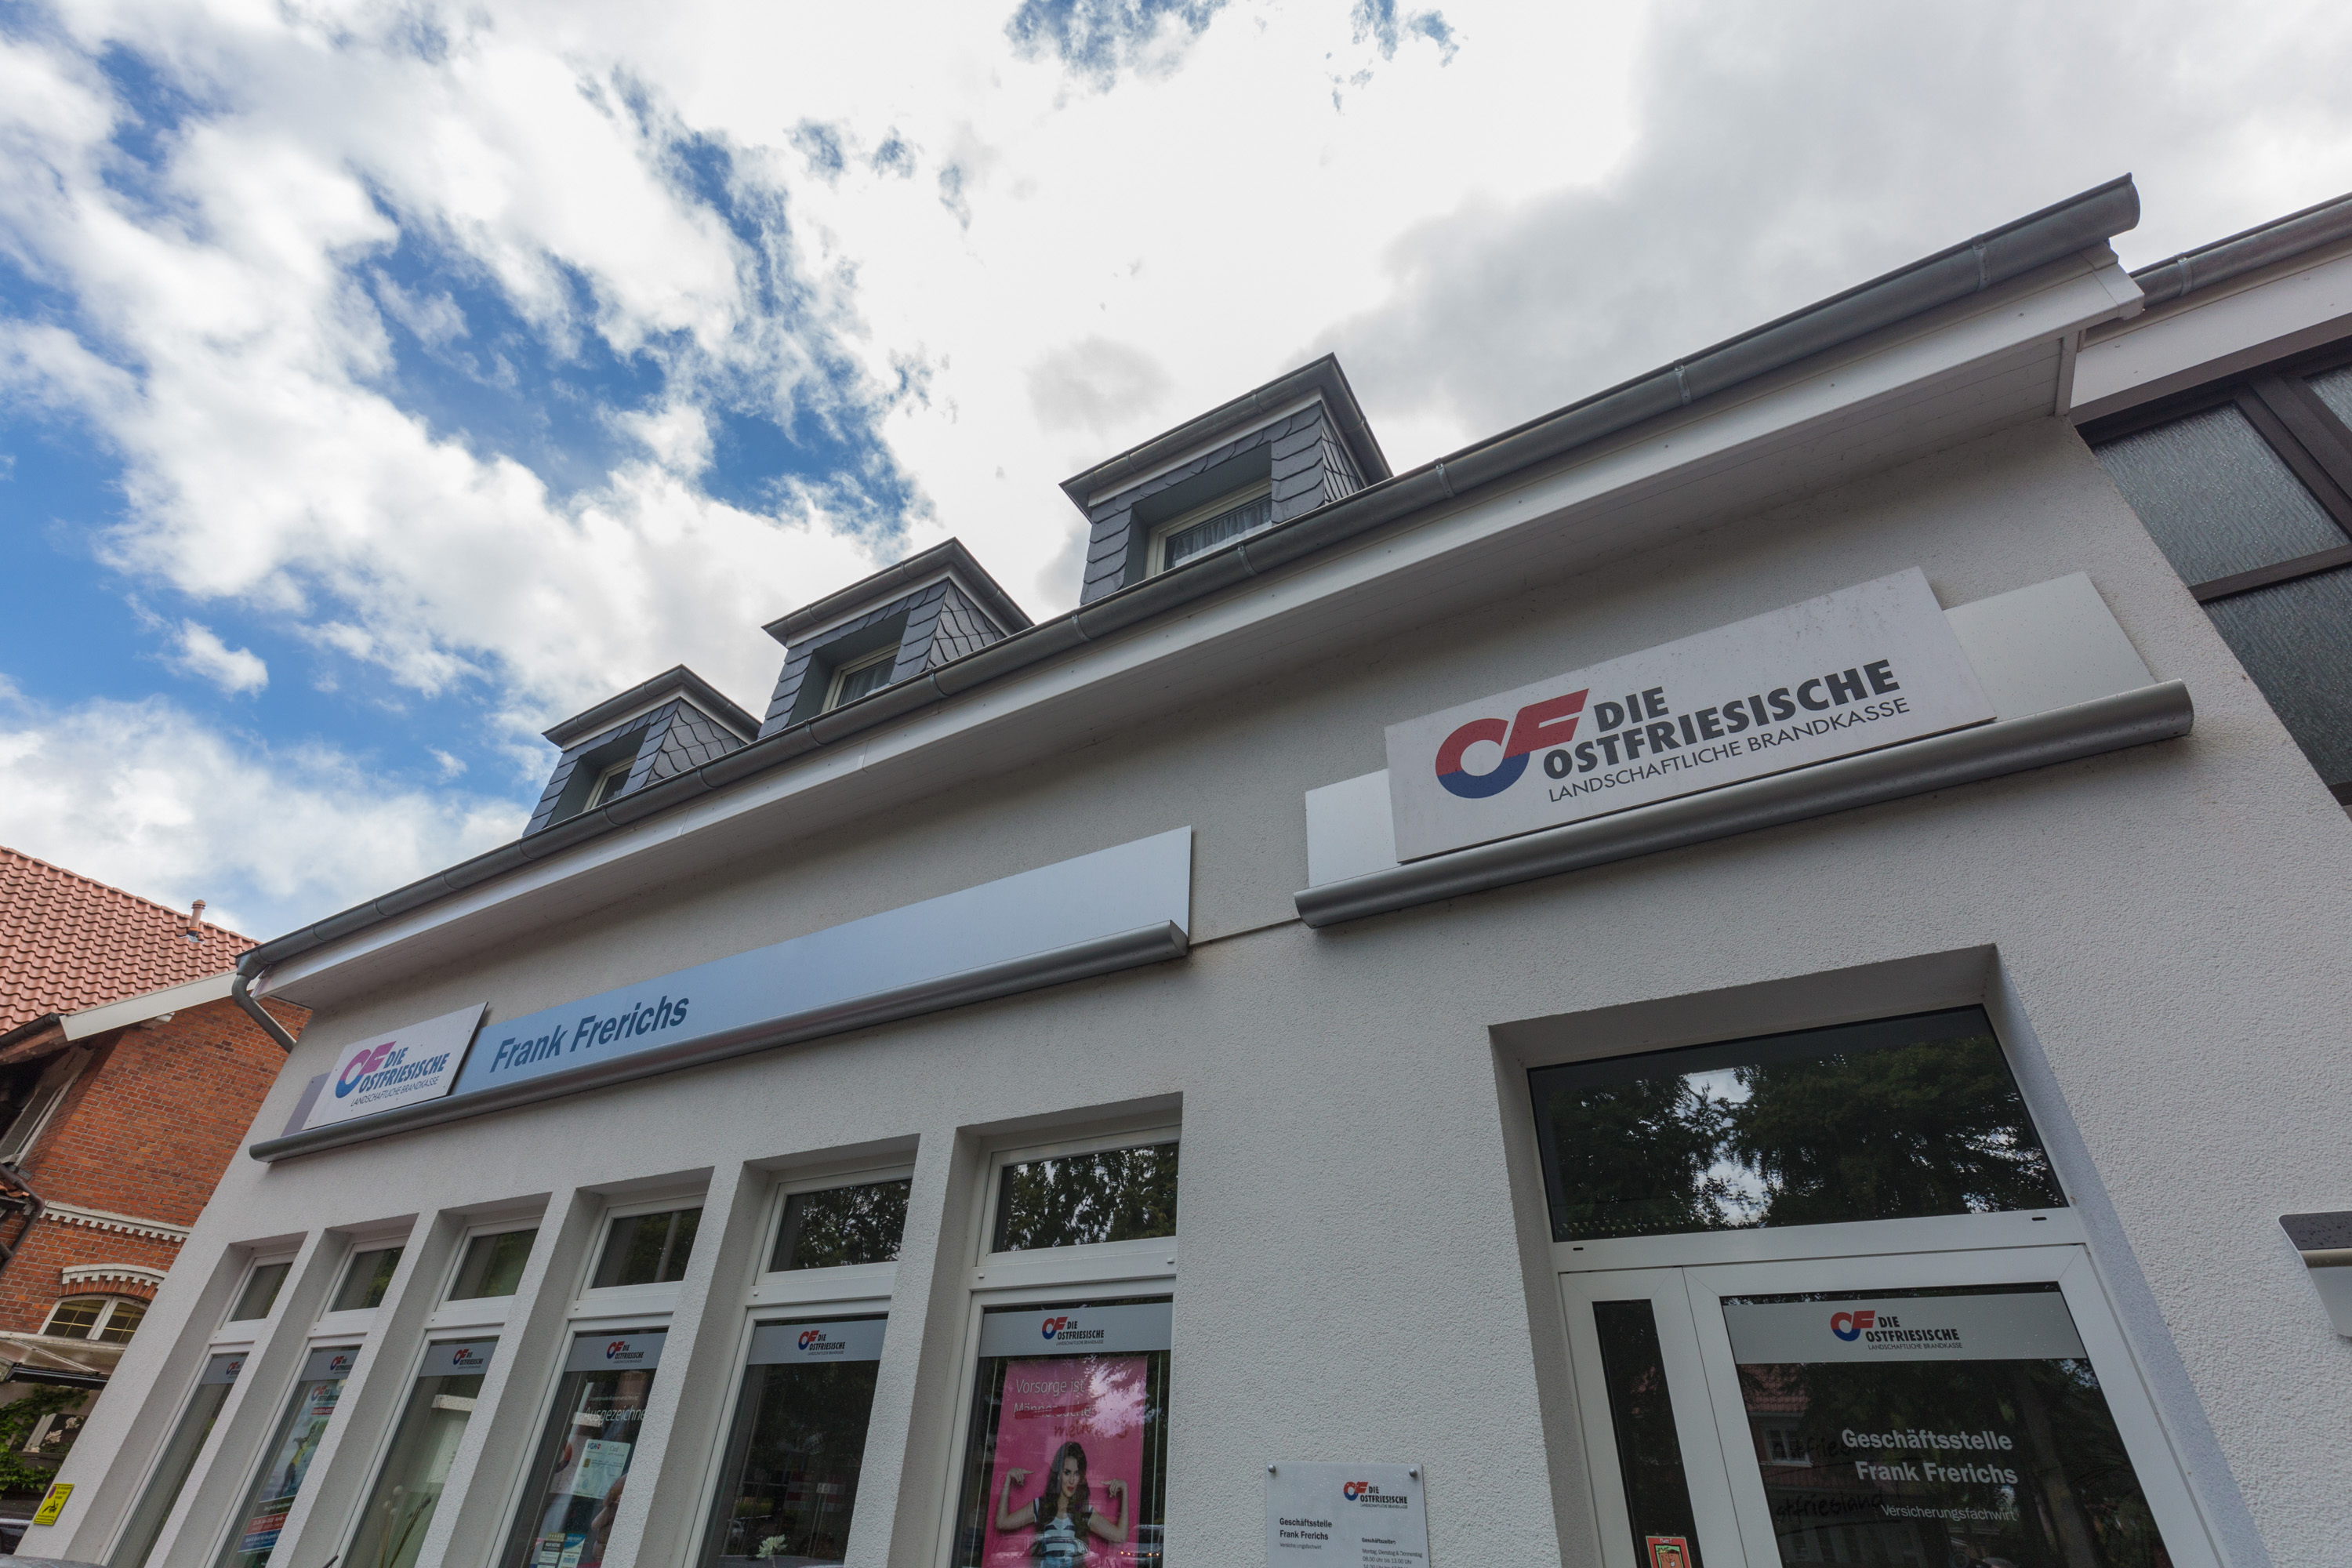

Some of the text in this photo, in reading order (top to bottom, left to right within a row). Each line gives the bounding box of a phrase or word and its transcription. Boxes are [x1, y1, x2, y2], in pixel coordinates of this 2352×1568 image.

[1594, 686, 1669, 733] DIE
[1542, 659, 1900, 780] OSTFRIESISCHE
[1548, 698, 1910, 803] LANDSCHAFTLICHE BRANDKASSE
[489, 996, 690, 1073] Frank Frerichs
[383, 1047, 408, 1069] DIE
[358, 1053, 450, 1093] OSTFRIESISCHE
[350, 1076, 439, 1107] LANDSCHAFTLICHE BRANDKASSE
[1067, 1321, 1078, 1330] DIE
[1878, 1316, 1900, 1327] DIE
[1058, 1330, 1105, 1340] OSTFRIESISCHE
[1866, 1329, 1959, 1342] OSTFRIESISCHE
[809, 1341, 846, 1351] OSTFRIESISCHE
[1016, 1377, 1084, 1396] Vorsorge ist
[1842, 1429, 2013, 1450] Geschäftsstelle
[1855, 1461, 2019, 1484] Frank Frerichs
[1360, 1495, 1407, 1504] OSTFRIESISCHE
[1279, 1517, 1332, 1527] Geschäftsstelle
[1881, 1504, 2017, 1523] Versicherungsfachwirt
[1279, 1530, 1329, 1540] Frank Frerichs
